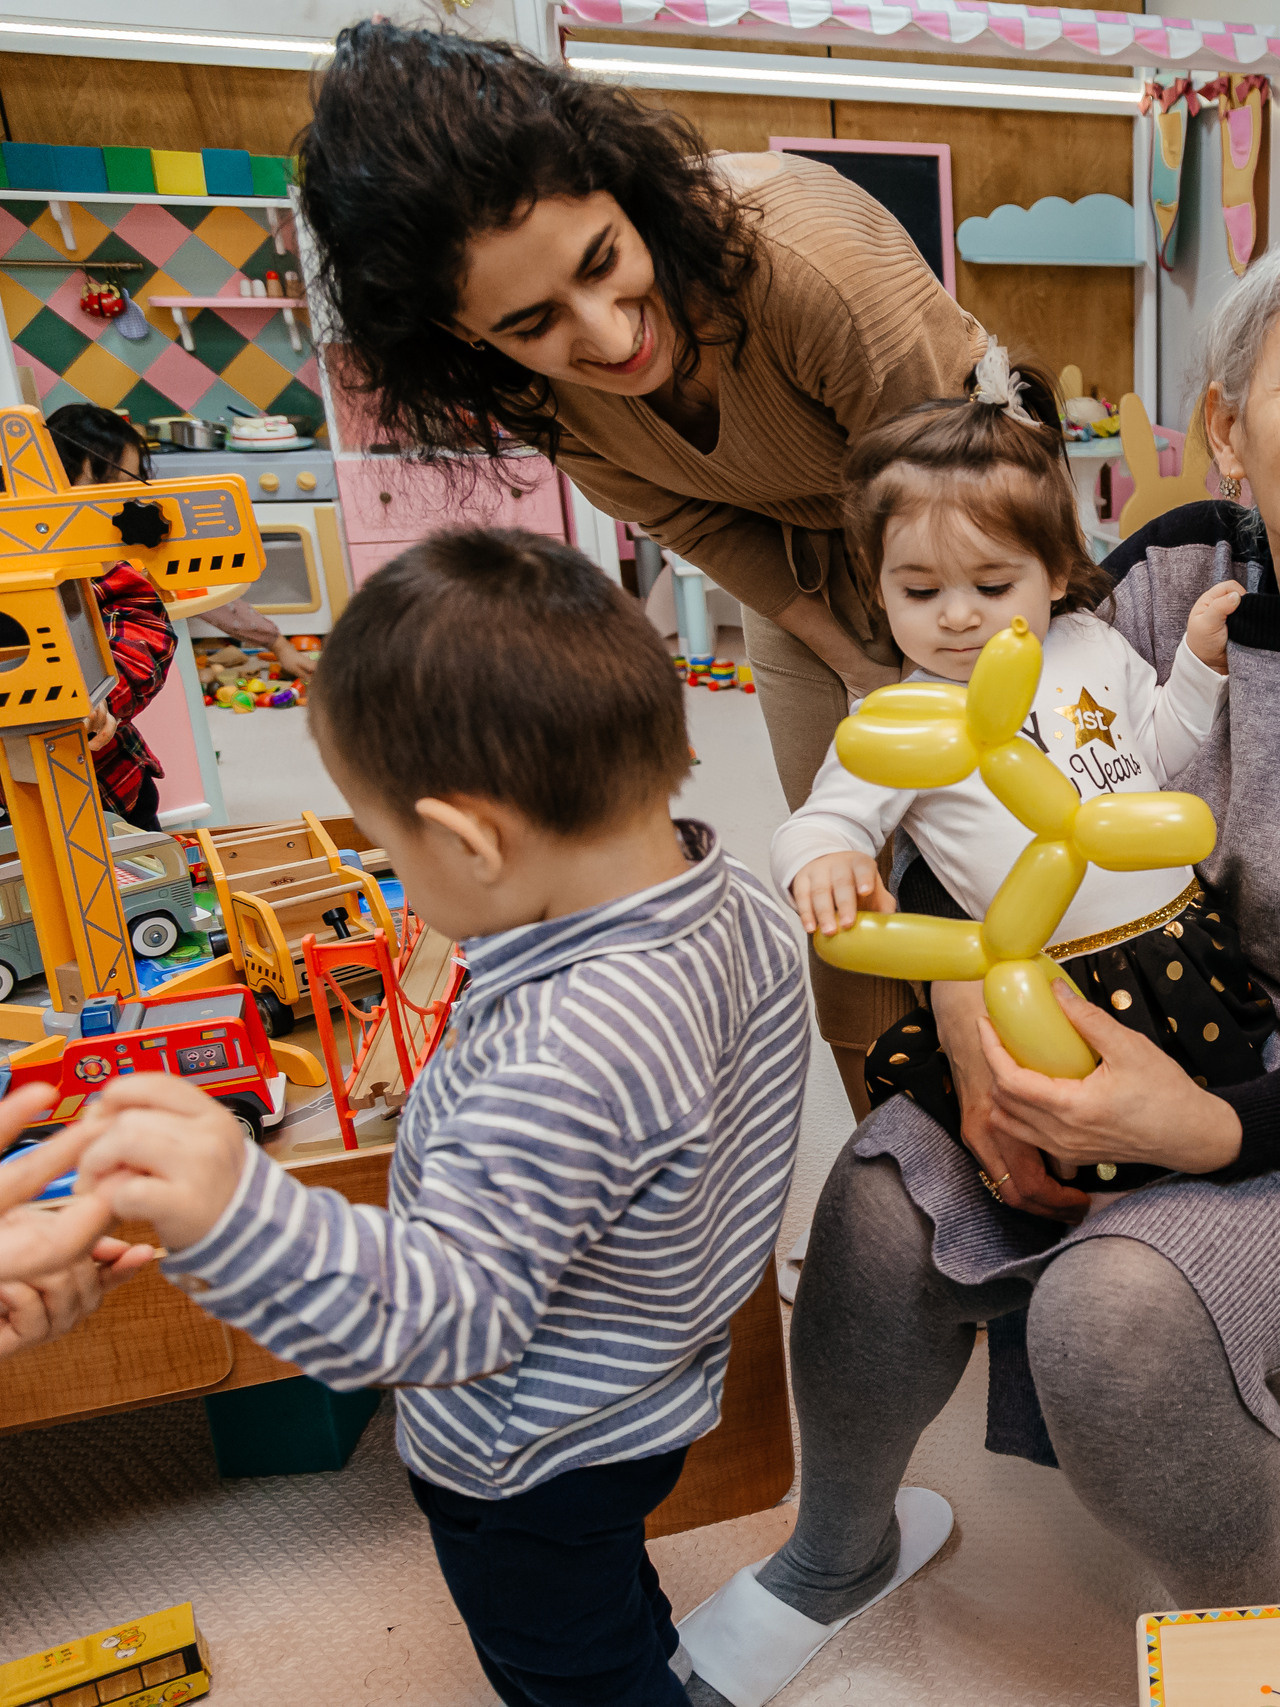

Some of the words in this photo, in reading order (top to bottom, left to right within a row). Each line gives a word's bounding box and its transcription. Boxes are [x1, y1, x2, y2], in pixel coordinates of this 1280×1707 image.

[1020, 711, 1050, 754] Y
[1074, 708, 1109, 731] 1st
[1069, 747, 1142, 794] Years
